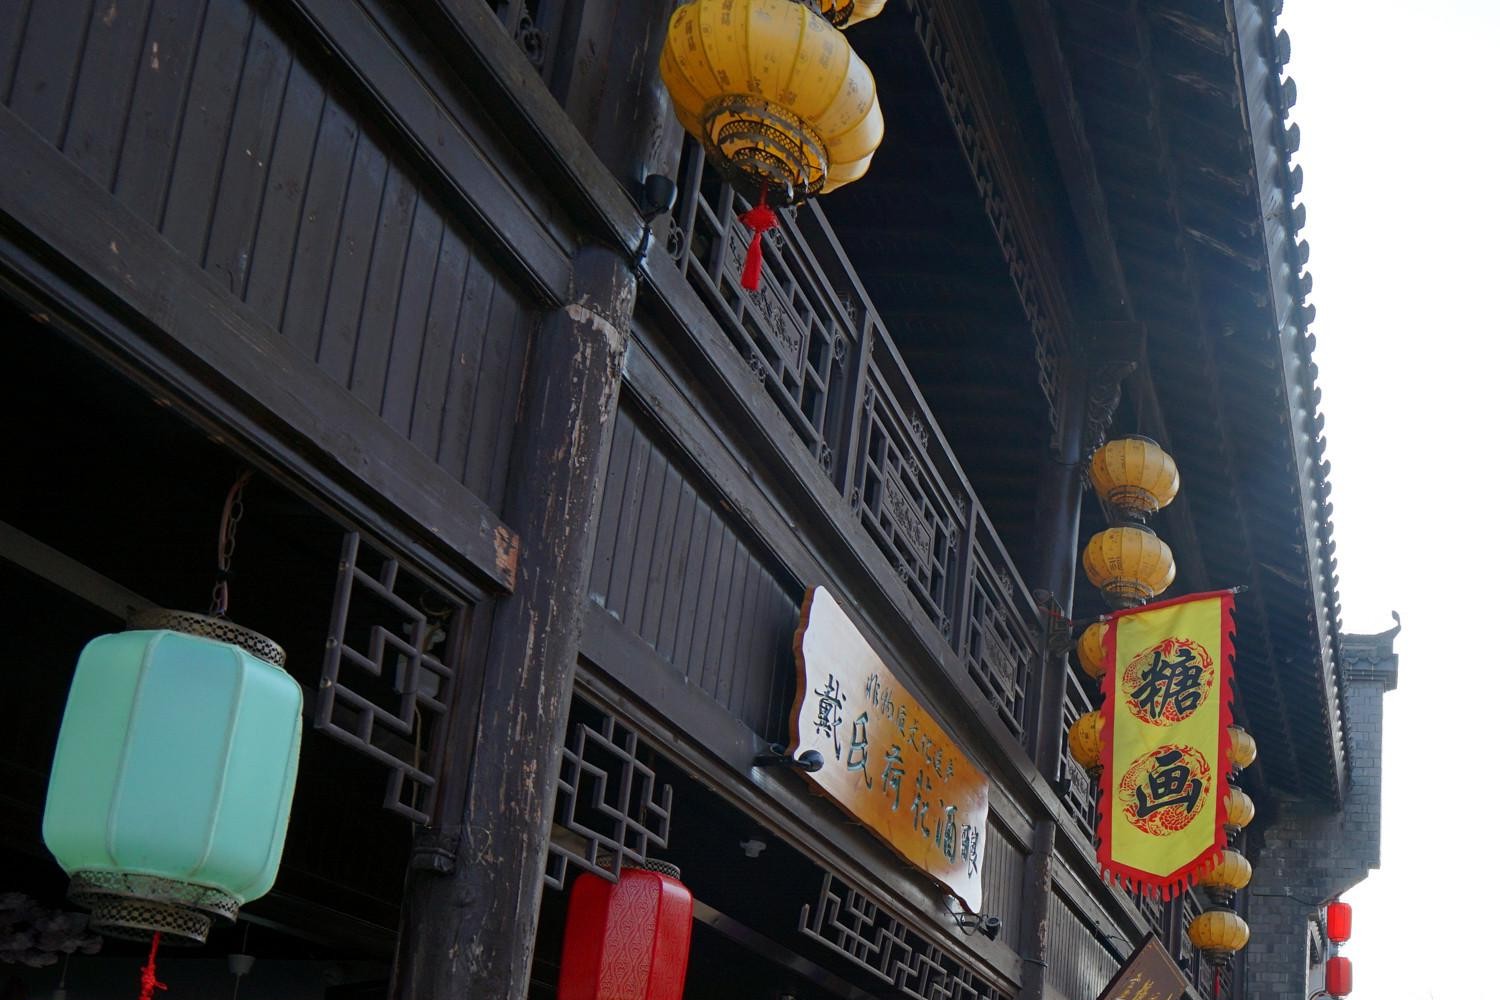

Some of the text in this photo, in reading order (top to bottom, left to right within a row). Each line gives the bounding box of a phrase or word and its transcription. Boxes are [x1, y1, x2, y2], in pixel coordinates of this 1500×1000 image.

[814, 673, 978, 878] 戴氏荷花酒酿
[1130, 649, 1203, 820] 糖画
